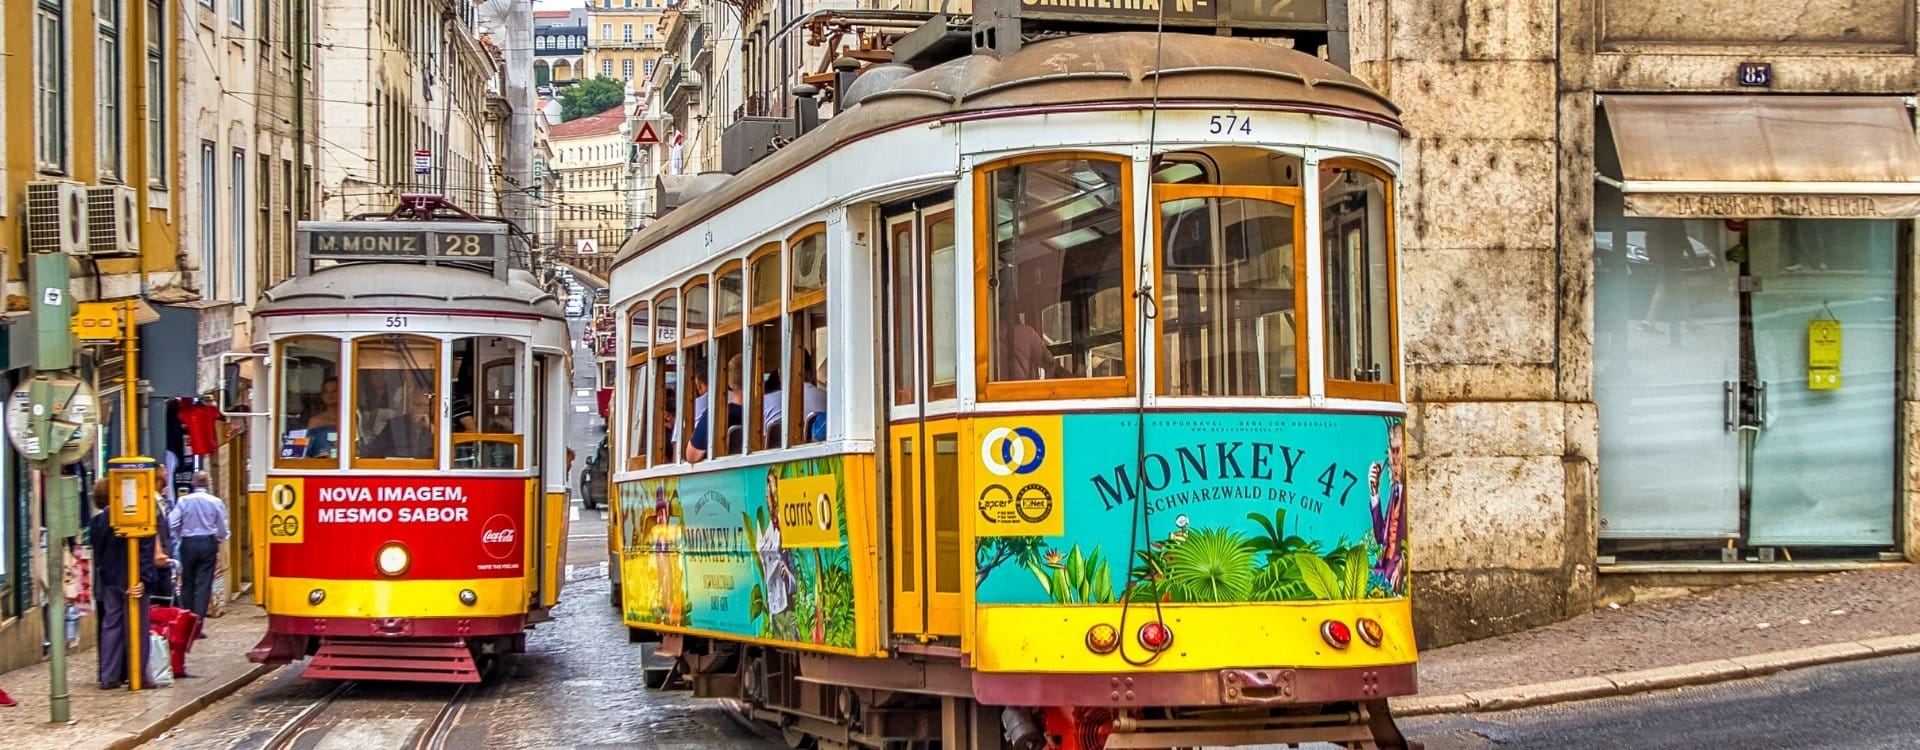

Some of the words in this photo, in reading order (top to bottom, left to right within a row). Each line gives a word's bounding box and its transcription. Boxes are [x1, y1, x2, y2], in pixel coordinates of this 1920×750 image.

[1209, 116, 1252, 135] 574
[1677, 197, 1694, 215] LA
[343, 236, 416, 251] MONIZ
[445, 235, 481, 256] 28
[386, 317, 408, 328] 551
[1090, 442, 1305, 511] MONKEY
[1317, 462, 1358, 506] 47
[319, 487, 372, 502] NOVA
[377, 486, 468, 503] IMAGEM,
[1145, 486, 1262, 515] SCHWARZWALD
[1268, 486, 1296, 504] DRY
[1300, 496, 1323, 514] GIN
[318, 508, 393, 523] MESMO
[398, 507, 468, 522] SABOR
[784, 491, 813, 527] carris
